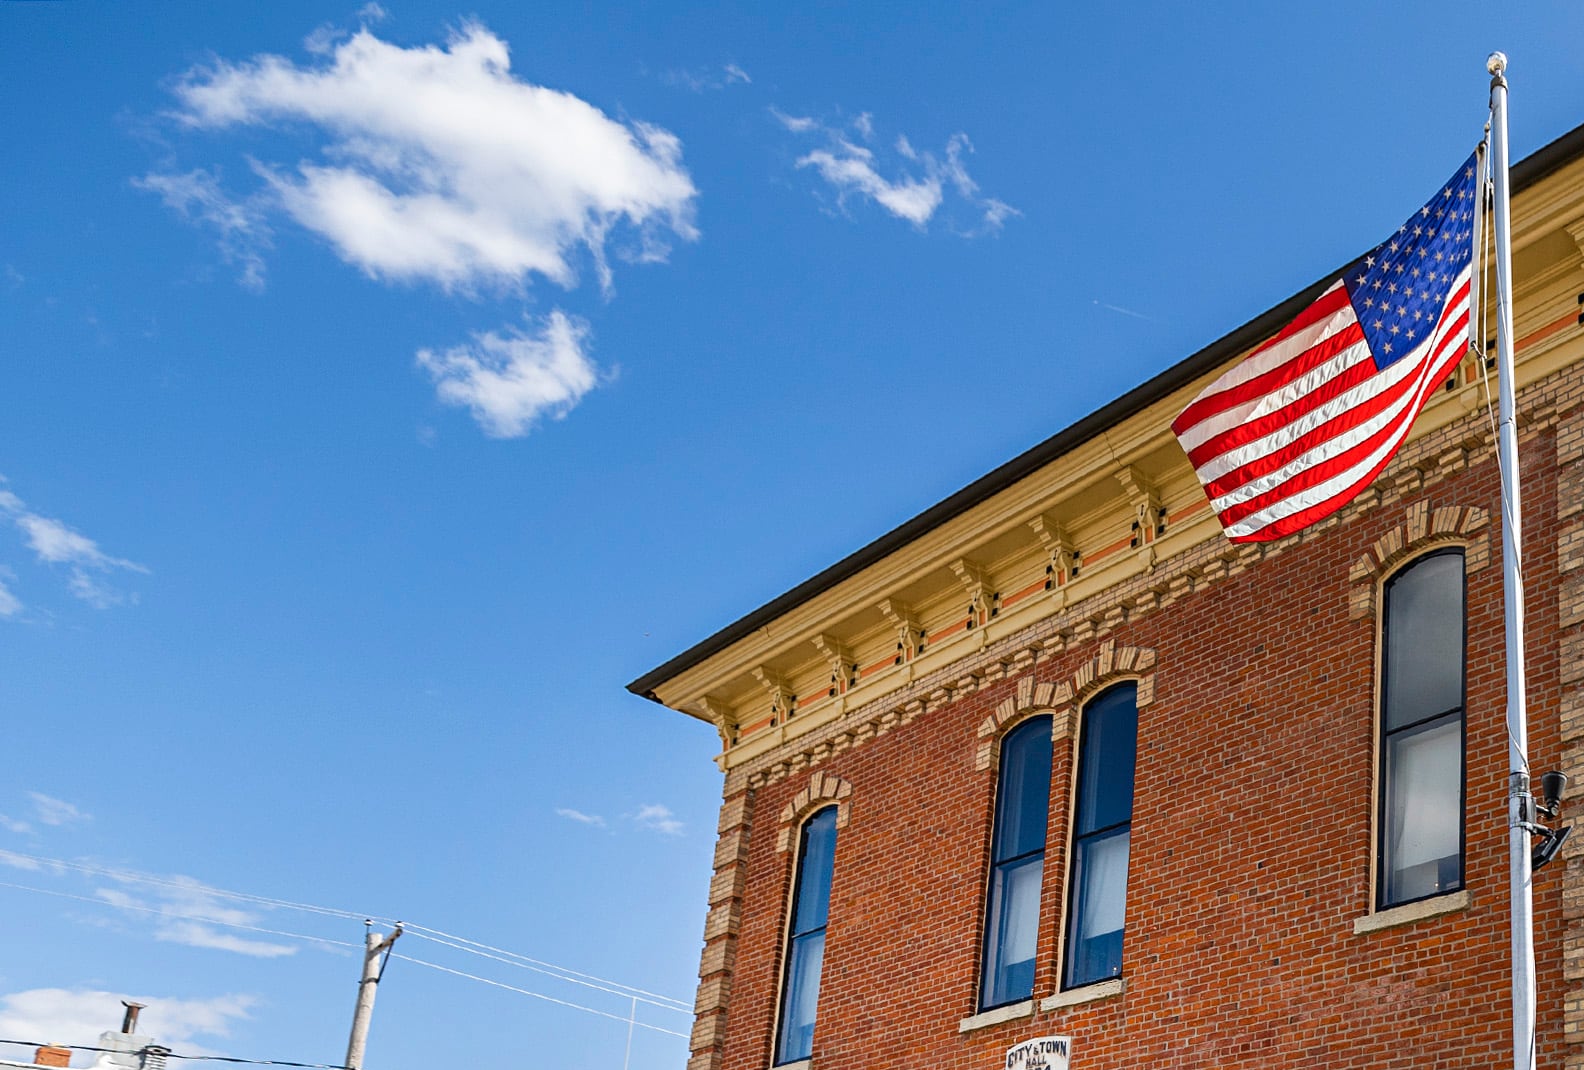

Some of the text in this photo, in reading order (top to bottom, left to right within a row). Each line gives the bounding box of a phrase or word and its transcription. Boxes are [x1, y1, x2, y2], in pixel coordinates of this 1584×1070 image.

[1007, 1043, 1033, 1069] CITY
[1039, 1040, 1067, 1057] TOWN
[1026, 1056, 1047, 1067] HALL
